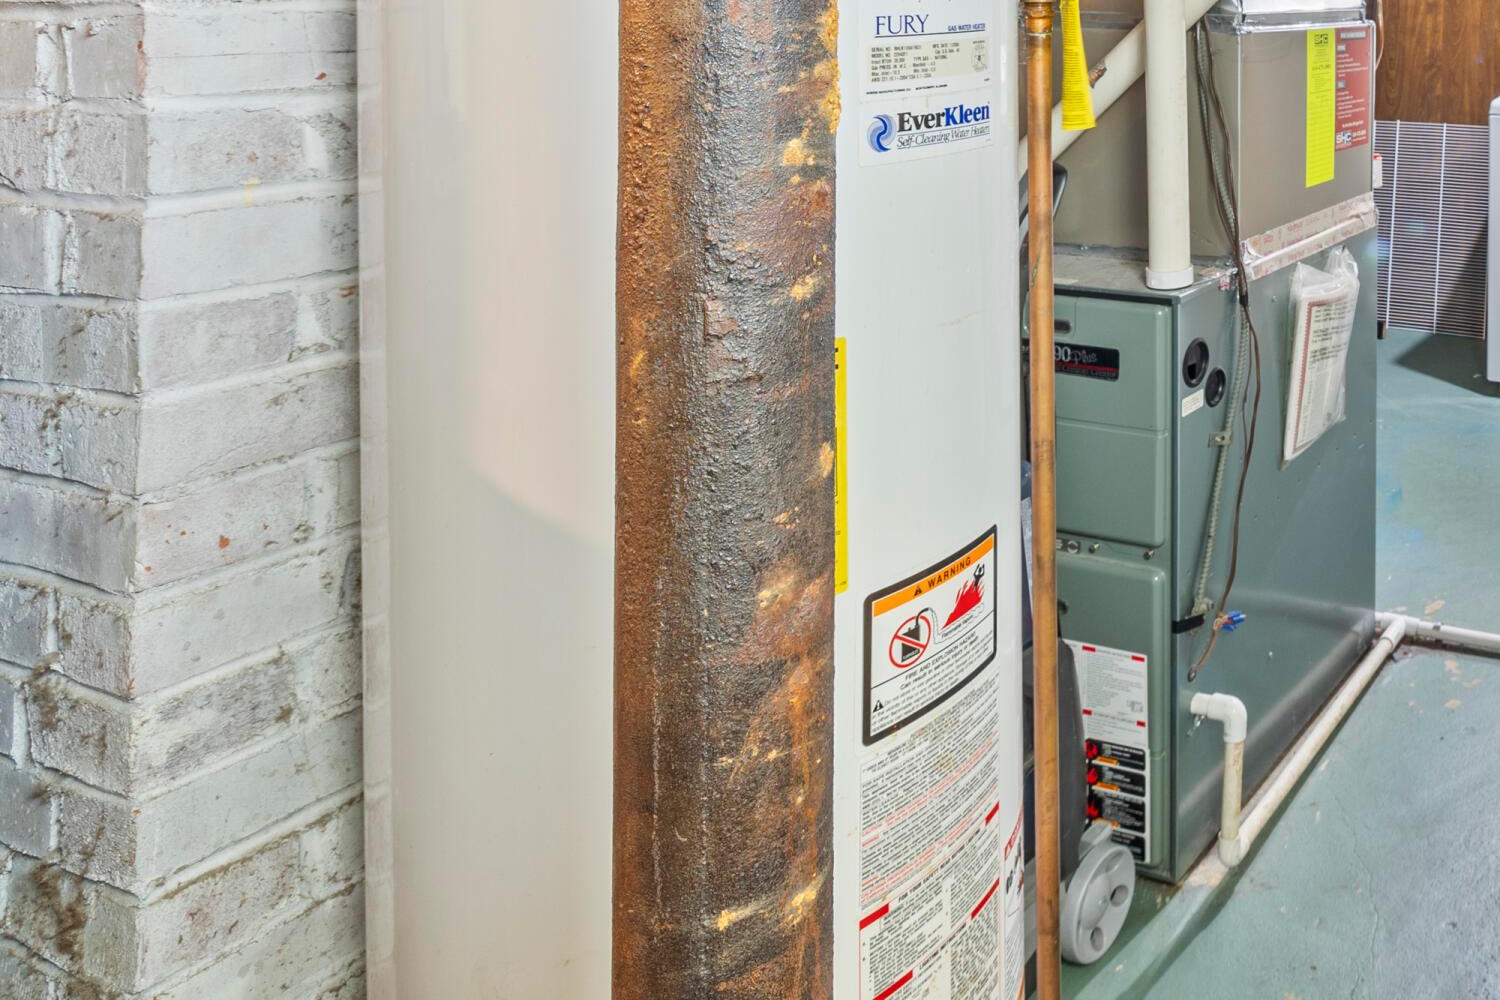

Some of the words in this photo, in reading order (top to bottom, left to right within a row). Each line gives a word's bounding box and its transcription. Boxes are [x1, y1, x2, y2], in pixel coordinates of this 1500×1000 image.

[876, 14, 929, 35] FURY
[897, 104, 990, 132] EverKleen
[897, 130, 951, 149] Self-Cleaning
[928, 556, 972, 588] WARNING
[919, 662, 931, 672] AND
